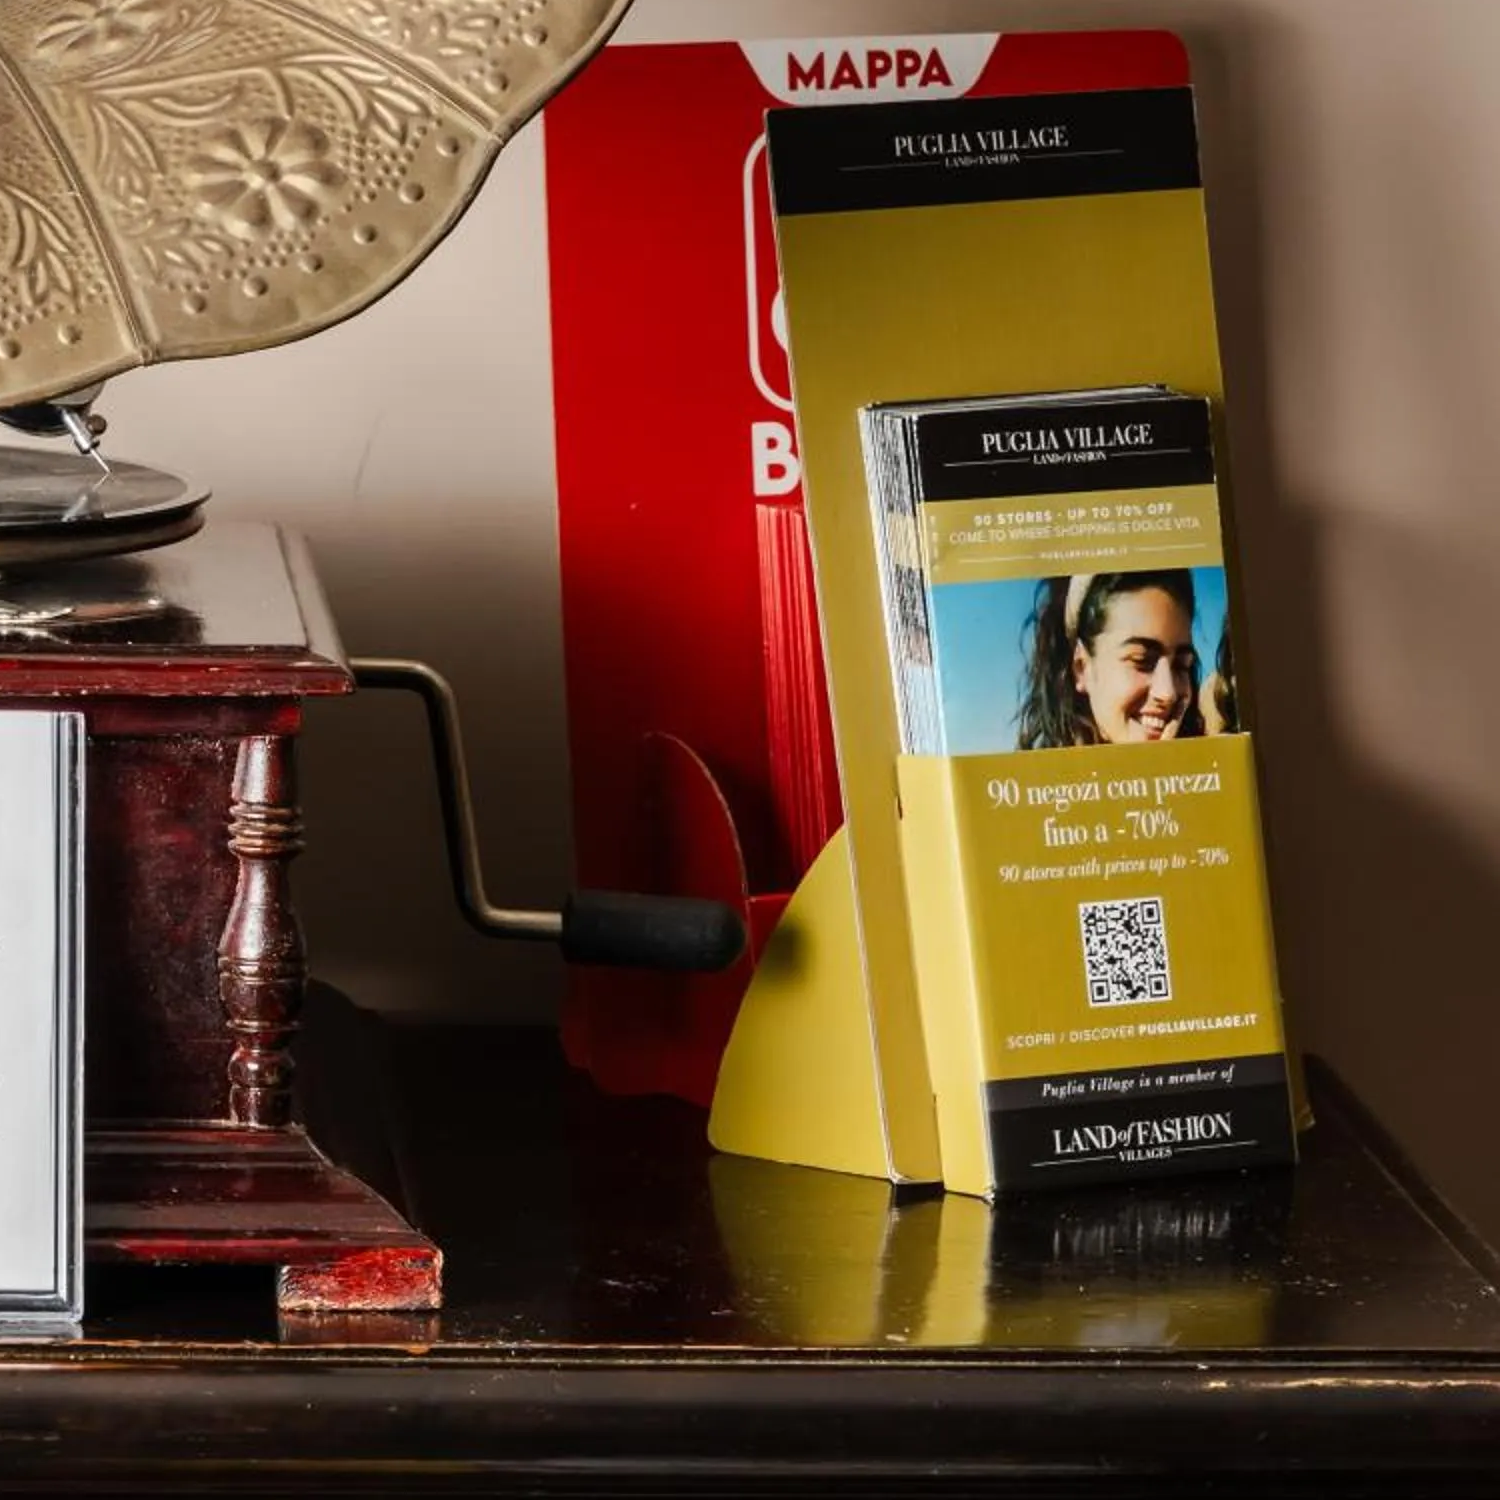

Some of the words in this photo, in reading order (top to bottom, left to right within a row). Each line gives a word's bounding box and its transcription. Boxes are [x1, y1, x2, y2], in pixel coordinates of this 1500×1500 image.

[787, 47, 954, 91] MAPPA
[894, 132, 971, 157] PUGLIA
[976, 125, 1069, 150] VILLAGE
[982, 429, 1059, 454] PUGLIA
[1064, 424, 1154, 448] VILLAGE
[950, 531, 986, 544] COME
[988, 529, 1005, 542] TO
[1132, 519, 1172, 532] DOLCE
[1174, 517, 1200, 530] VITA
[997, 511, 1052, 524] STORES
[1067, 509, 1086, 520] UP
[1092, 507, 1110, 518] TO
[1147, 504, 1173, 514] OFF
[987, 778, 1020, 808] 90
[1027, 771, 1100, 812] negozi
[1107, 780, 1147, 800] con
[1154, 760, 1221, 805] prezzi
[1043, 816, 1087, 847] fino
[1095, 824, 1109, 842] a
[1116, 808, 1179, 840] -70%
[999, 865, 1019, 883] 90
[1023, 864, 1065, 882] stores
[1068, 857, 1100, 878] with
[1104, 855, 1145, 880] prices
[1149, 857, 1169, 876] up
[1172, 854, 1186, 869] to
[1190, 847, 1229, 867] -70%
[1007, 1034, 1055, 1049] SCOPRI
[1069, 1026, 1135, 1044] DISCOVER
[1138, 1013, 1257, 1036] PUGLIAVILLAGE.IT
[1042, 1081, 1085, 1099] Puglia
[1089, 1076, 1134, 1092] Village
[1140, 1072, 1150, 1088] is
[1155, 1075, 1163, 1086] a
[1168, 1068, 1216, 1085] member
[1221, 1064, 1235, 1083] of
[1053, 1124, 1117, 1155] LAND
[1116, 1121, 1135, 1146] of
[1135, 1112, 1233, 1145] FASHION
[1118, 1146, 1173, 1162] VILLAGES
